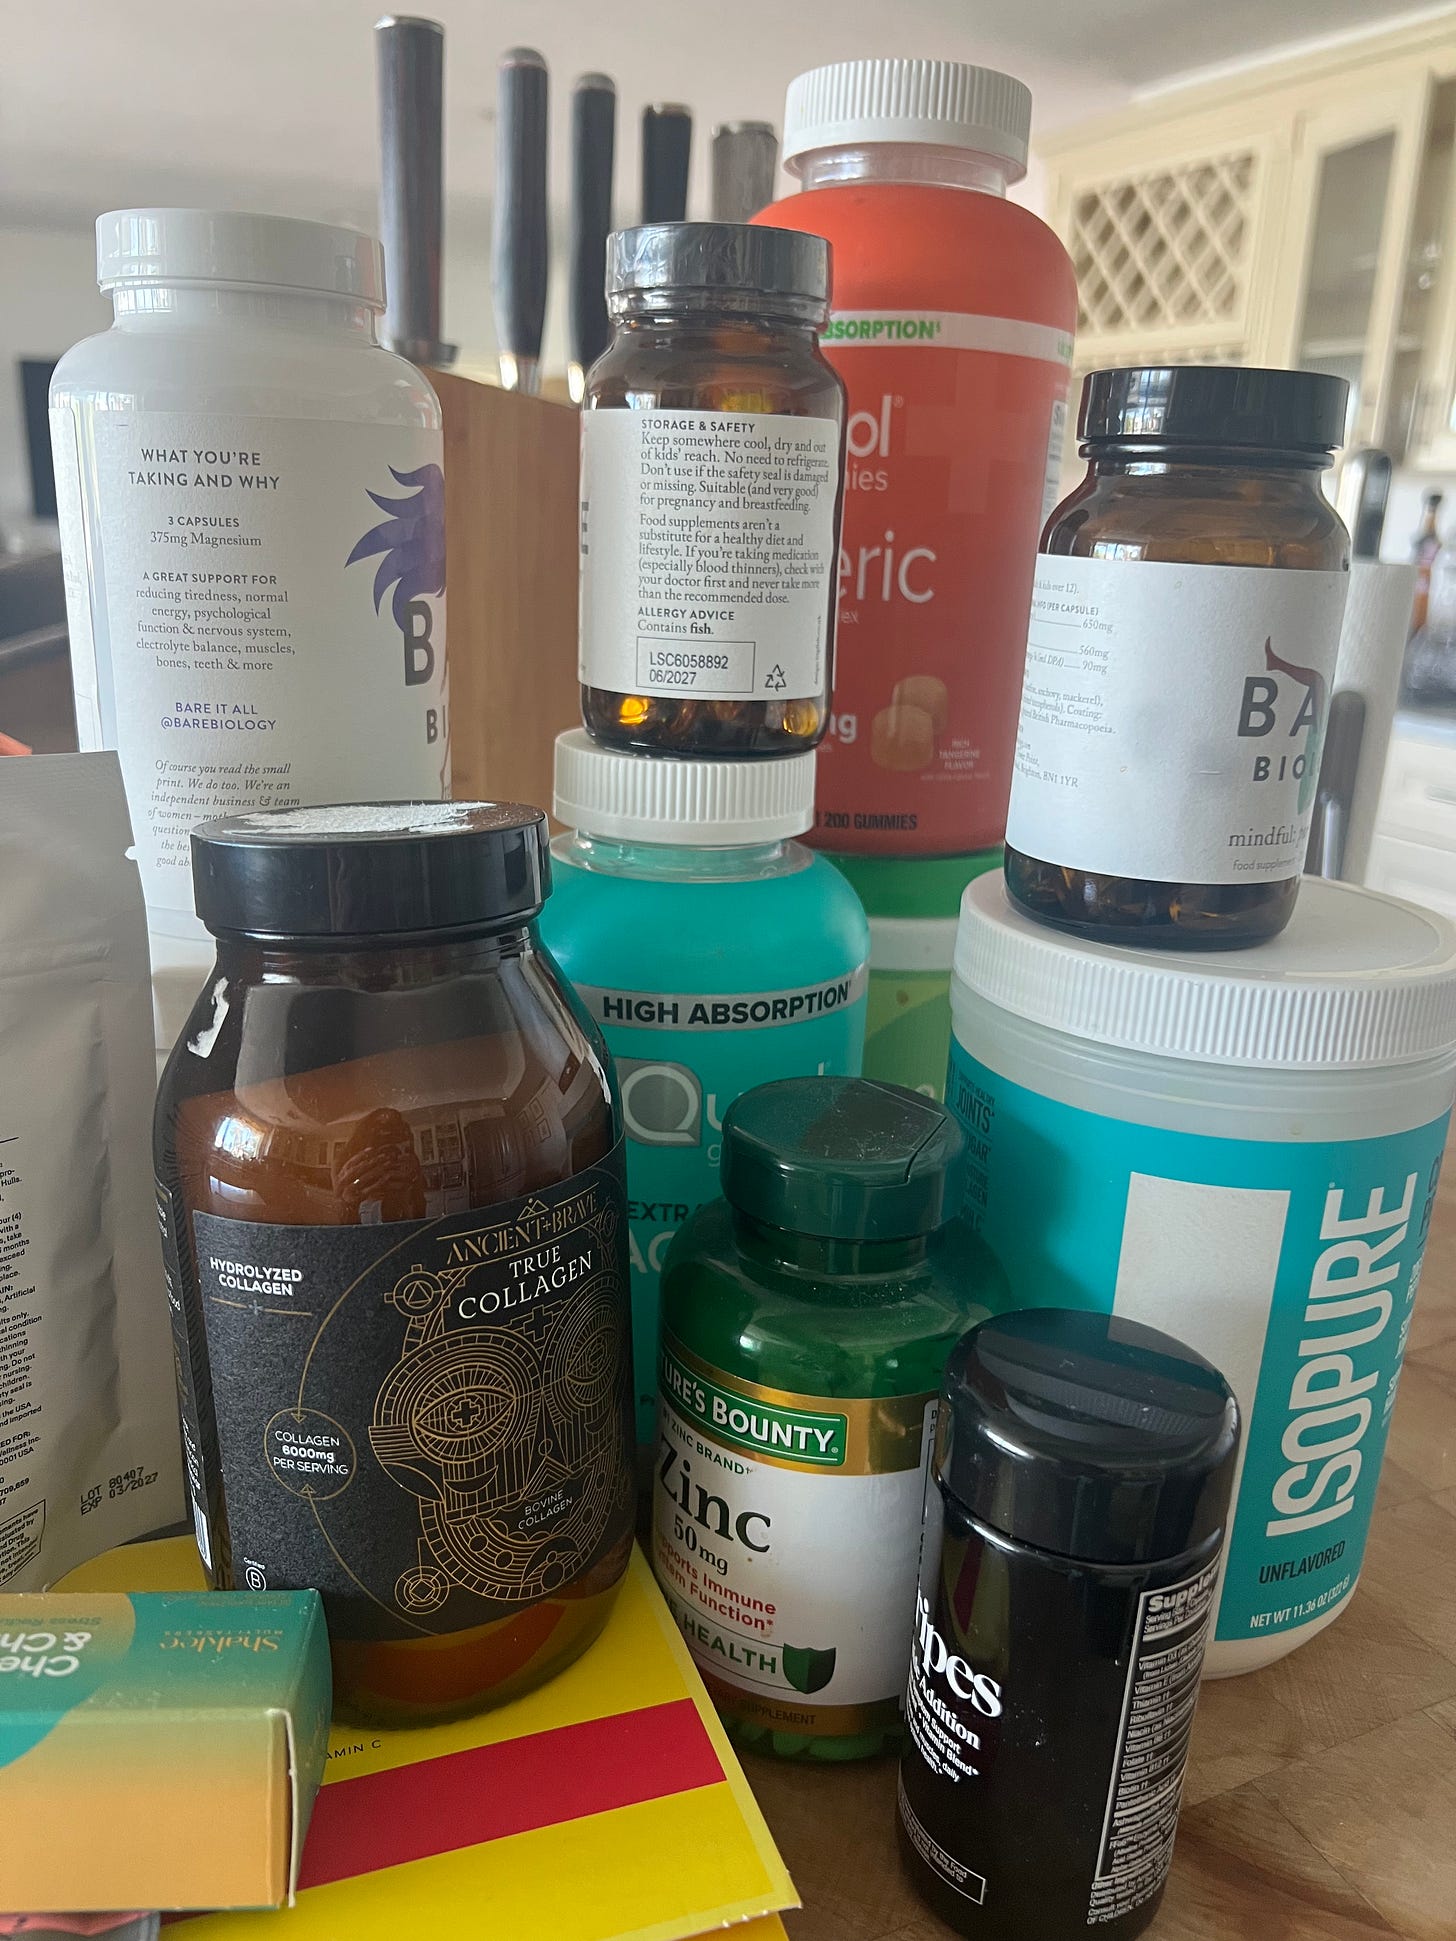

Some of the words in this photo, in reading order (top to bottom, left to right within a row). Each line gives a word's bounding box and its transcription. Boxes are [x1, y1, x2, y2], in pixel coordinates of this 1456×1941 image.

[642, 420, 694, 430] STORAGE
[700, 422, 706, 430] &
[711, 422, 755, 433] SAFETY
[642, 432, 669, 450] Keep
[673, 435, 740, 448] somewhere
[744, 437, 771, 450] cool,
[775, 438, 792, 454] dry
[795, 440, 811, 451] and
[814, 443, 826, 451] out
[141, 449, 188, 463] WHAT
[641, 448, 652, 459] of
[685, 451, 720, 462] reach.
[725, 452, 743, 463] No
[747, 453, 771, 464] need
[774, 455, 784, 465] to
[128, 472, 188, 486] TAKING
[194, 474, 232, 487] AND
[240, 476, 280, 490] WHY
[675, 467, 692, 476] use
[696, 465, 707, 477] if
[708, 466, 725, 478] the
[728, 468, 759, 483] safety
[763, 468, 781, 480] seal
[785, 471, 791, 481] is
[794, 470, 829, 484] damaged
[846, 463, 889, 491] ies
[640, 493, 655, 505] for
[658, 498, 716, 510] pregnancy
[719, 497, 739, 509] and
[743, 498, 810, 514] breastfeeding.
[168, 517, 174, 525] 3
[178, 517, 240, 527] CAPSULES
[640, 514, 665, 526] Food
[668, 517, 739, 531] supplements
[775, 522, 780, 530] a
[151, 532, 187, 547] 375mg
[191, 533, 261, 547] Magnesium
[143, 572, 149, 580] A
[153, 572, 188, 582] GREAT
[192, 574, 248, 584] SUPPORT
[252, 575, 277, 584] FOR
[136, 587, 181, 603] reducing
[185, 589, 241, 602] tiredness,
[246, 591, 288, 602] normal
[152, 607, 190, 620] energy,
[195, 607, 271, 622] psychological
[638, 609, 687, 618] ALLERGY
[690, 611, 735, 620] ADVICE
[138, 621, 179, 634] function
[183, 624, 194, 634] &
[198, 626, 243, 636] nervous
[247, 629, 291, 639] system,
[638, 620, 687, 633] Contains
[690, 624, 714, 635] fish.
[1083, 619, 1113, 633] 650mg
[137, 638, 189, 654] electrolyte
[193, 641, 241, 654] balance,
[246, 643, 295, 655] muscles,
[1080, 645, 1109, 660] 560mg
[157, 656, 190, 670] bones,
[195, 658, 222, 669] teeth
[227, 659, 239, 670] &
[243, 662, 273, 670] more
[649, 652, 728, 669] LSC6058892
[1083, 661, 1108, 675] 90mg
[649, 670, 696, 685] 06/2027
[176, 702, 211, 713] BARE
[217, 704, 227, 713] IT
[233, 705, 258, 714] ALL
[161, 717, 276, 730] @BAREBIOLOGY
[156, 760, 169, 772] Of
[169, 763, 196, 772] course
[199, 765, 216, 776] you
[219, 764, 241, 773] read
[244, 765, 259, 774] the
[263, 763, 291, 774] small
[157, 778, 183, 789] print.
[188, 779, 203, 789] We
[206, 780, 217, 789] do
[222, 782, 240, 790] too.
[825, 813, 848, 829] 200
[855, 813, 917, 830] GUMMIES
[604, 996, 678, 1024] HIGH
[210, 1257, 302, 1282] HYDROLYZED
[509, 1246, 561, 1278] TRUE
[219, 1274, 293, 1296] COLLAGEN
[458, 1251, 592, 1319] COLLAGEN
[9, 1316, 42, 1331] condition
[1266, 1172, 1417, 1536] ISOPURE
[2, 1409, 14, 1418] the
[16, 1402, 31, 1412] USA
[661, 1356, 706, 1414] URE'S
[712, 1396, 835, 1452] BOUNTY
[10, 1406, 42, 1423] imported
[275, 1431, 340, 1447] COLLAGEN
[671, 1422, 693, 1447] ZINC
[282, 1445, 335, 1463] 6000mg
[274, 1457, 295, 1470] PER
[297, 1461, 349, 1474] SERVING
[81, 1485, 102, 1505] LOT
[109, 1467, 145, 1488] 80407
[81, 1498, 102, 1515] EXP
[109, 1472, 158, 1499] 03/2027
[661, 1432, 771, 1553] Zinc
[524, 1490, 564, 1516] BOVINE
[518, 1497, 573, 1530] COLLAGEN
[674, 1517, 697, 1551] 50
[700, 1547, 727, 1576] mg
[1259, 1540, 1345, 1584] UNFLAVORED
[661, 1538, 698, 1579] pports
[703, 1575, 776, 1615] Immune
[1250, 1614, 1270, 1628] NET
[1274, 1608, 1291, 1623] WT
[1293, 1600, 1315, 1617] 11.36
[1317, 1592, 1327, 1608] OZ
[63, 1632, 91, 1649] &
[684, 1615, 776, 1674] HEALTH
[918, 1675, 980, 1750] Addition
[923, 1716, 945, 1753] Vitamin
[931, 1716, 961, 1755] Support
[371, 1740, 381, 1749] C
[943, 1762, 960, 1782] daily
